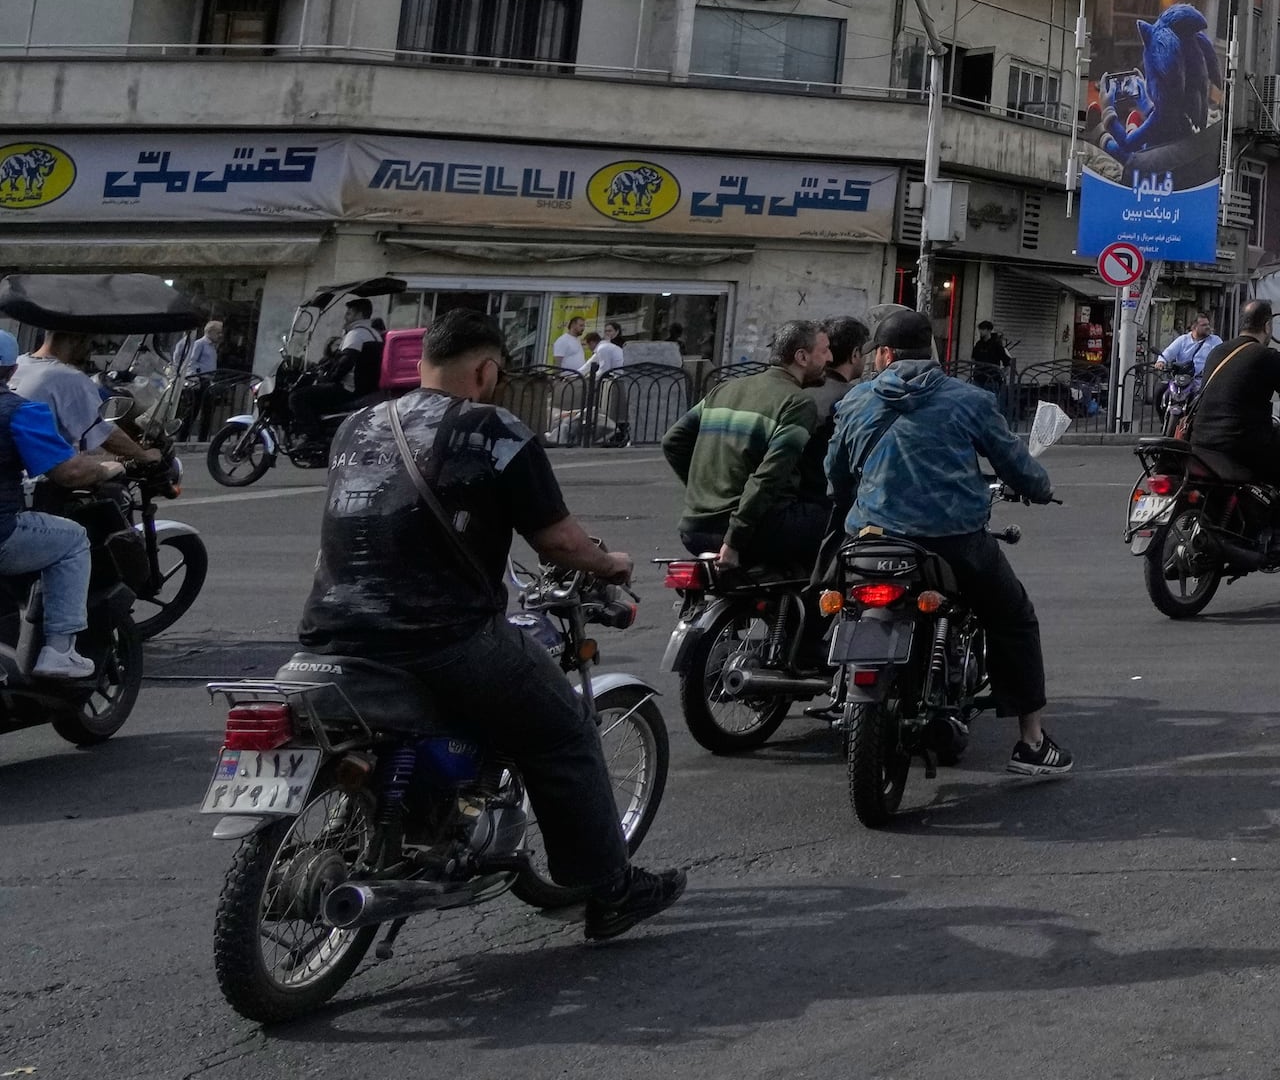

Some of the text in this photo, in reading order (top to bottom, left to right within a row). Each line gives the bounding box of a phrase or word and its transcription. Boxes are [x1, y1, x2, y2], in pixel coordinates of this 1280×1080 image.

[193, 147, 318, 193] کفش
[368, 159, 575, 200] MELLI
[535, 199, 572, 210] SHOES
[767, 177, 872, 218] کفش
[1144, 206, 1171, 223] مایکت
[1172, 208, 1180, 224] از
[288, 662, 343, 675] HONDA
